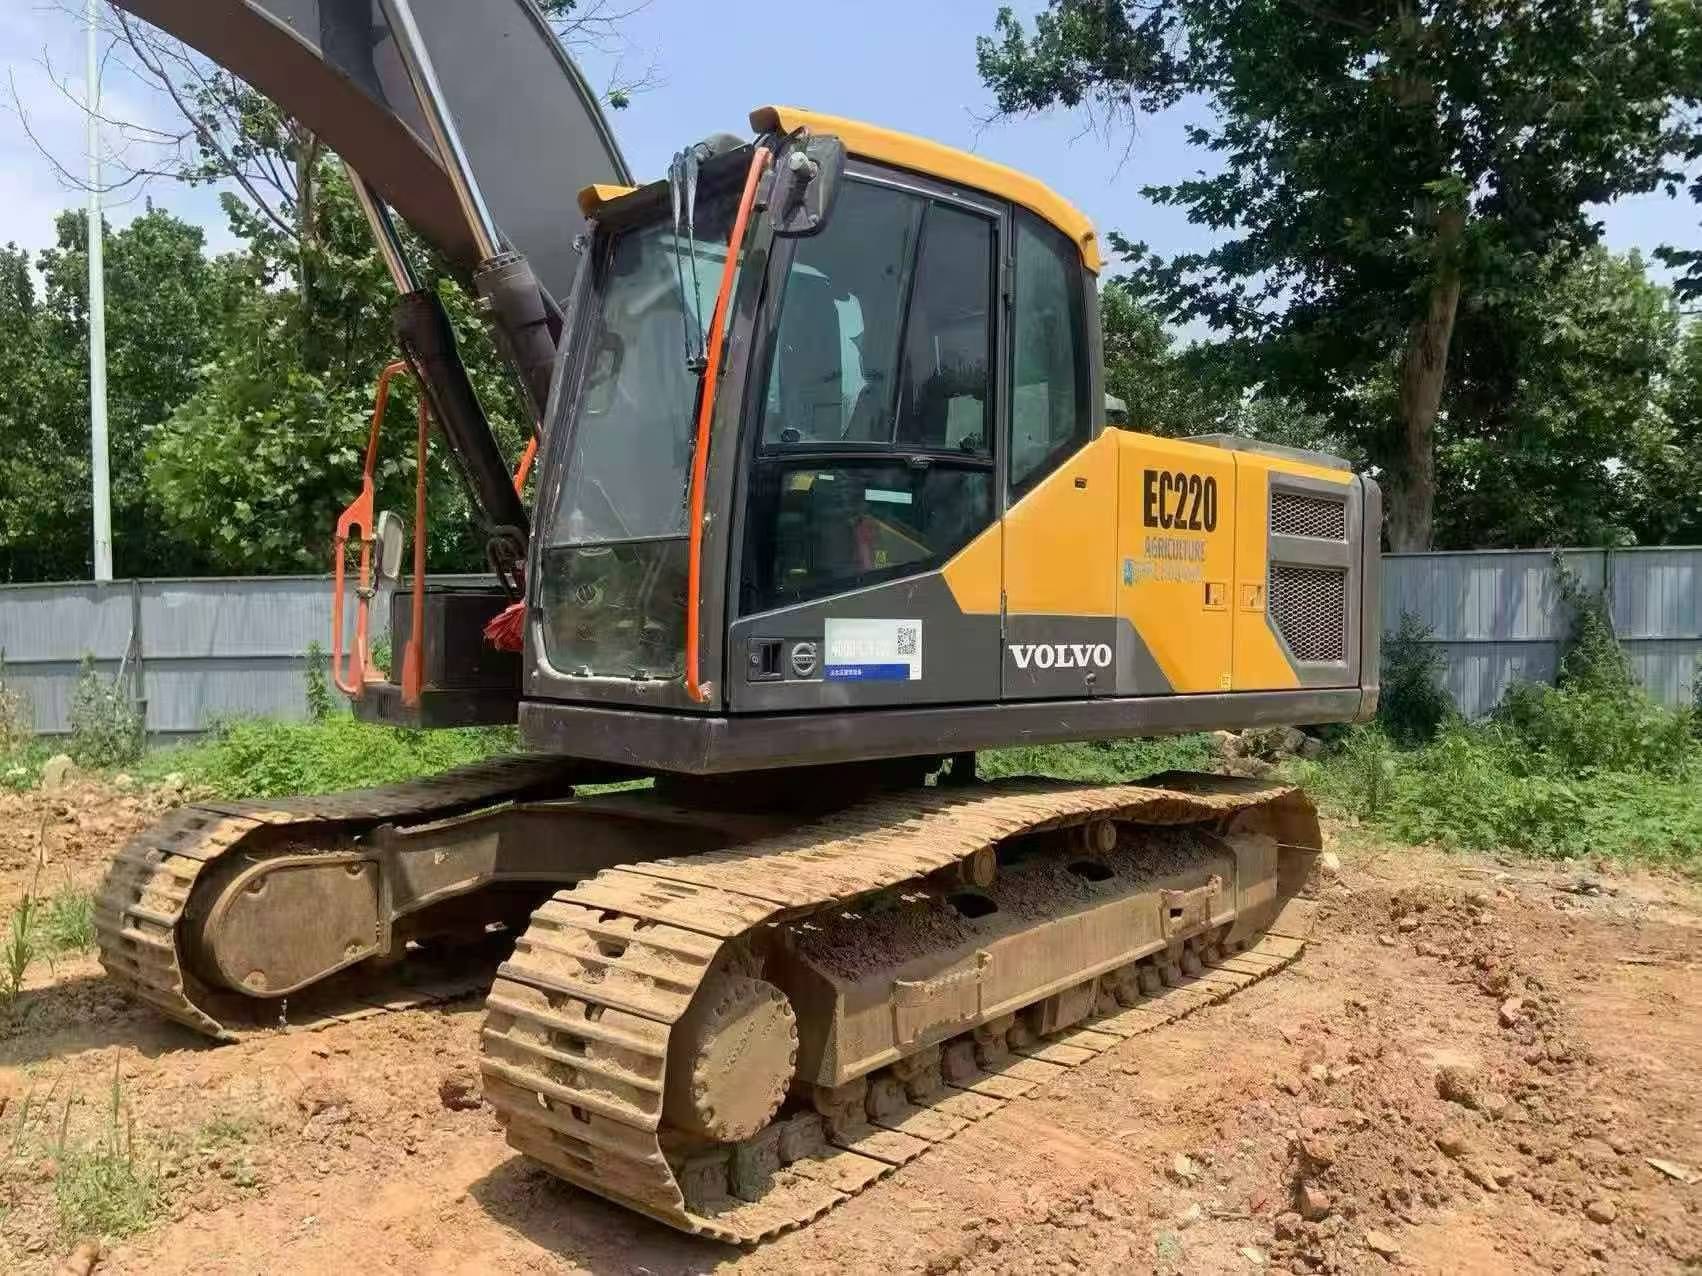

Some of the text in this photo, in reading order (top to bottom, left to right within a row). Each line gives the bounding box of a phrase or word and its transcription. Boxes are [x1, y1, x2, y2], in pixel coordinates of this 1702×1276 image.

[1143, 469, 1218, 533] EC220
[1144, 536, 1207, 562] AGRICULTURE
[1008, 643, 1112, 668] VOLVO
